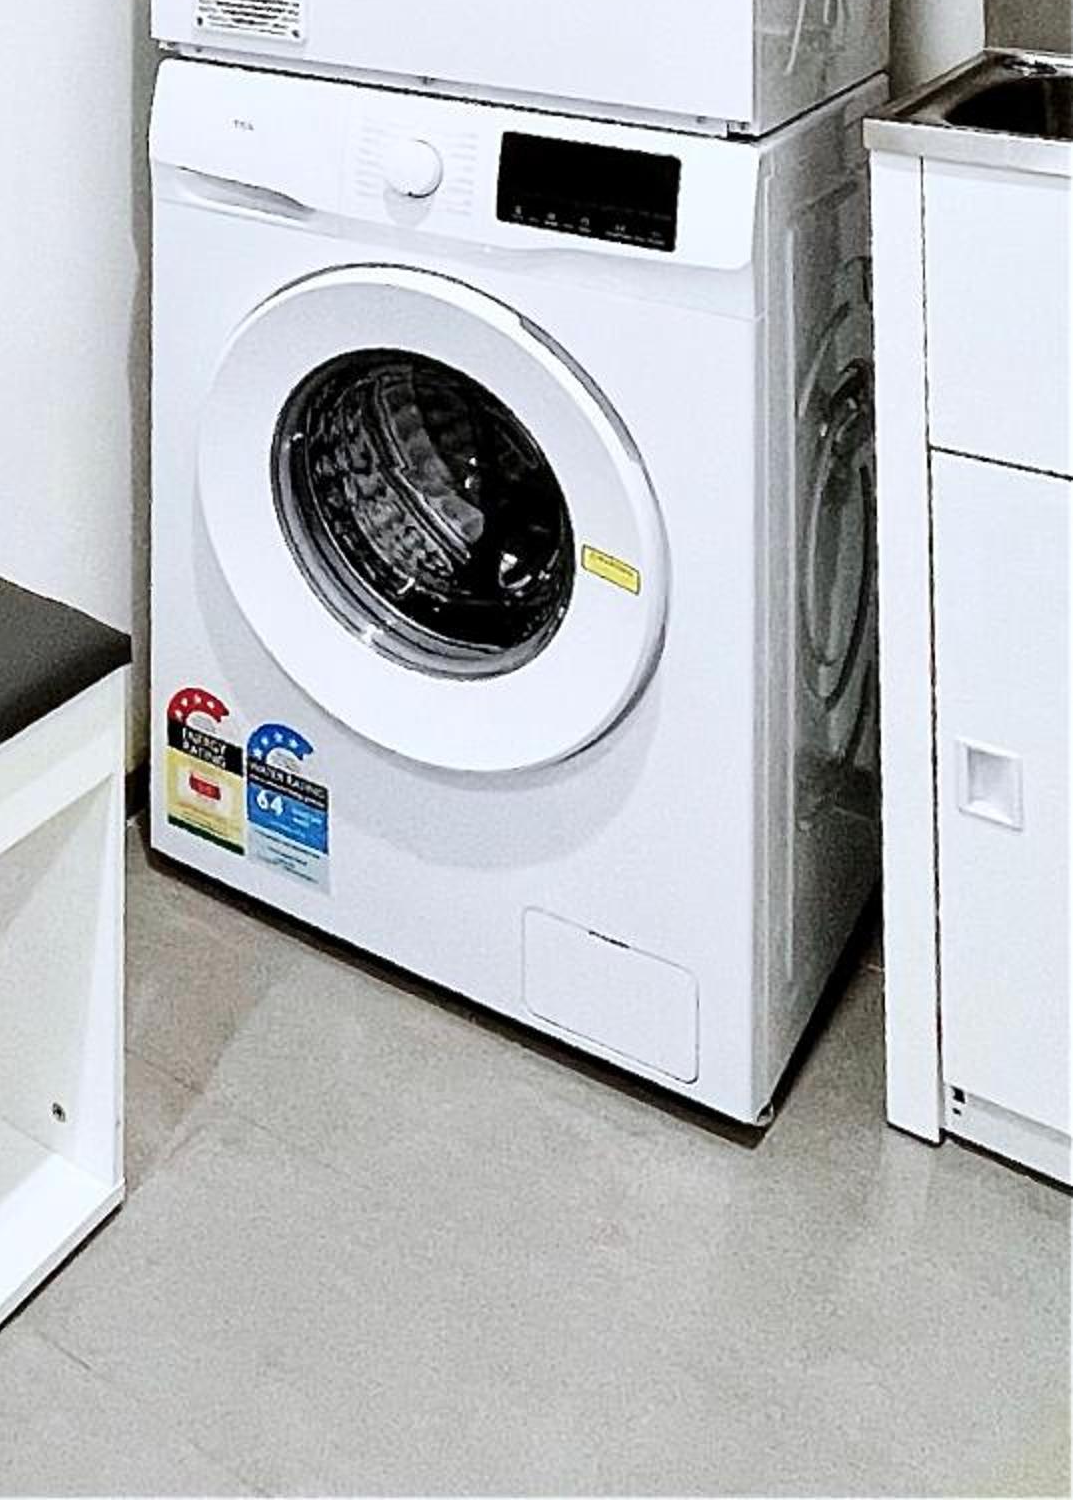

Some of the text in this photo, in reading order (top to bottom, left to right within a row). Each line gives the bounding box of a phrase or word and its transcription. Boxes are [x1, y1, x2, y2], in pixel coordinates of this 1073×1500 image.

[182, 727, 226, 755] ENERGY
[182, 740, 226, 769] RATING
[250, 762, 284, 784] WATER
[286, 773, 326, 799] RATING
[256, 789, 284, 816] 64
